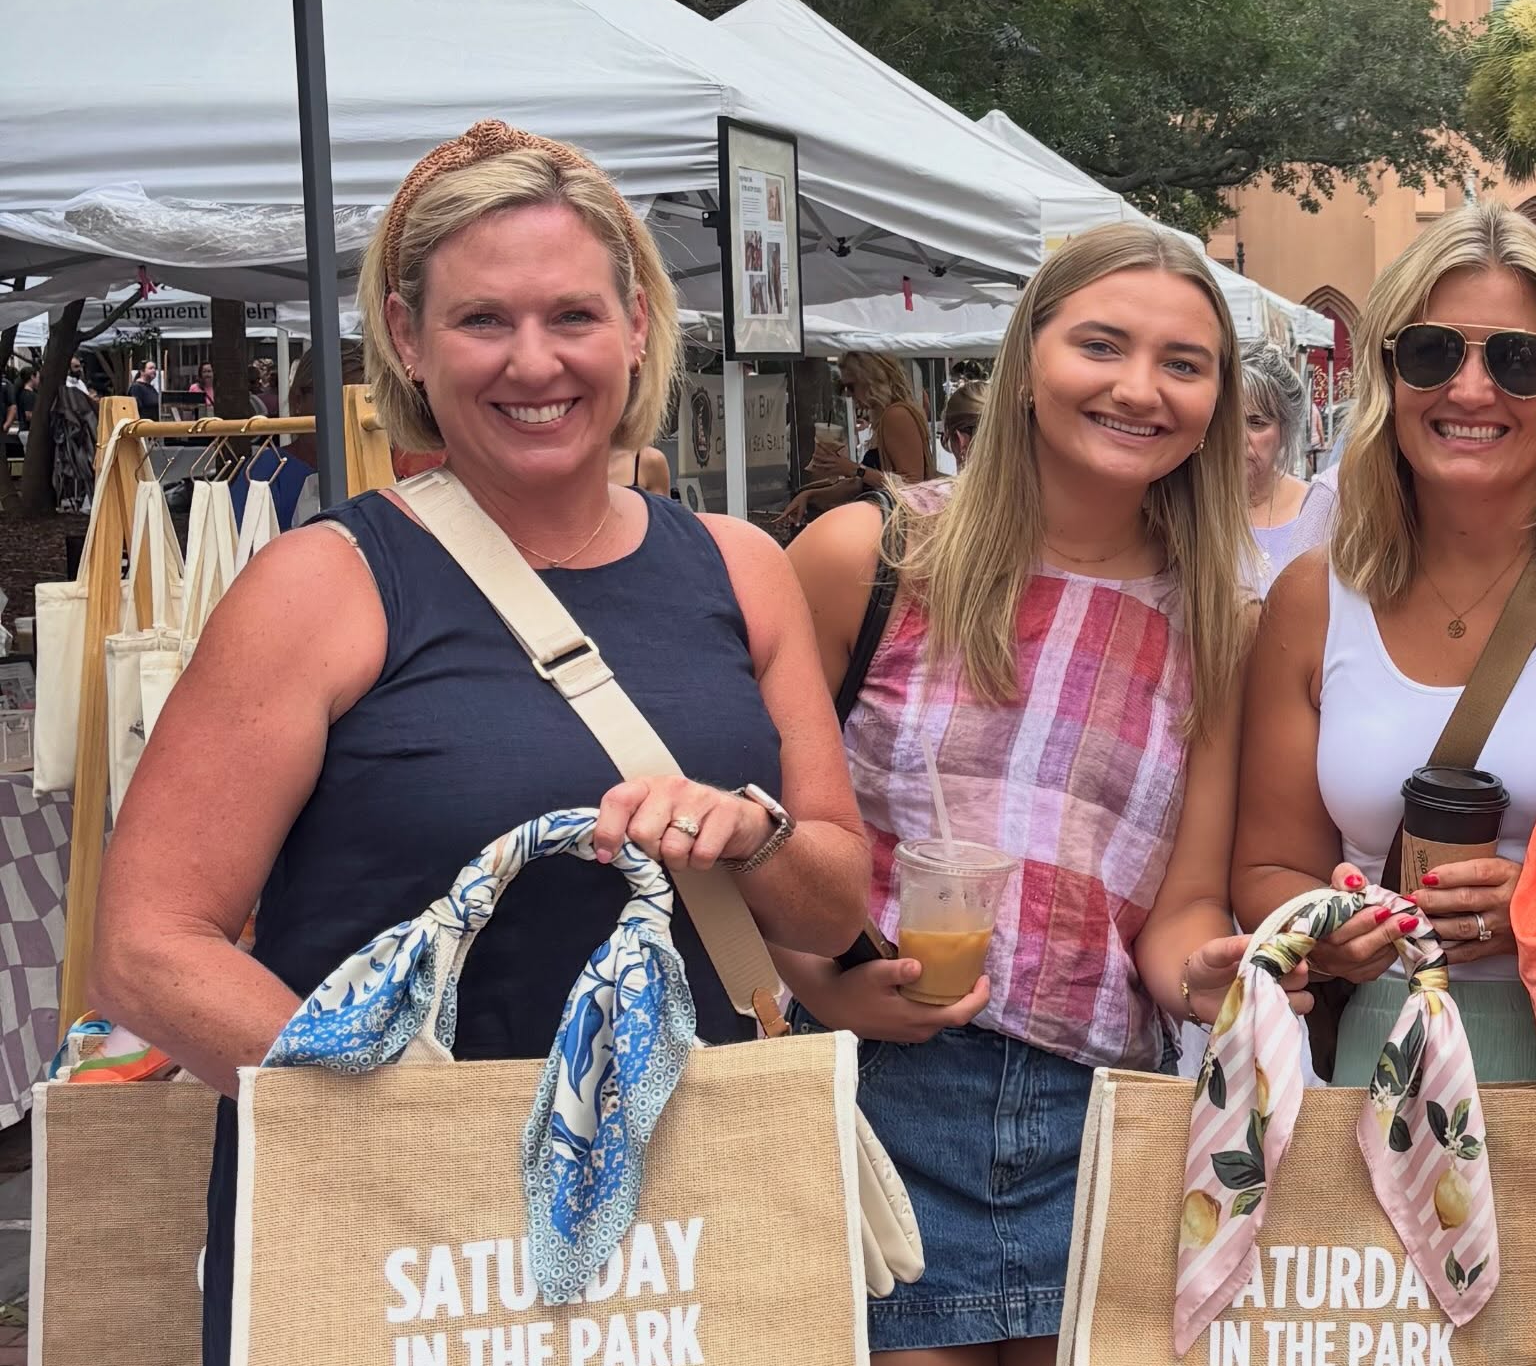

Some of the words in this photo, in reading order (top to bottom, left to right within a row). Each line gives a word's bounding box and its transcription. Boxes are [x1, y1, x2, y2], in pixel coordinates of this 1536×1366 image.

[102, 303, 207, 319] Prmanent
[384, 1217, 704, 1323] SATUDAY
[1232, 1245, 1446, 1310] ATURDA
